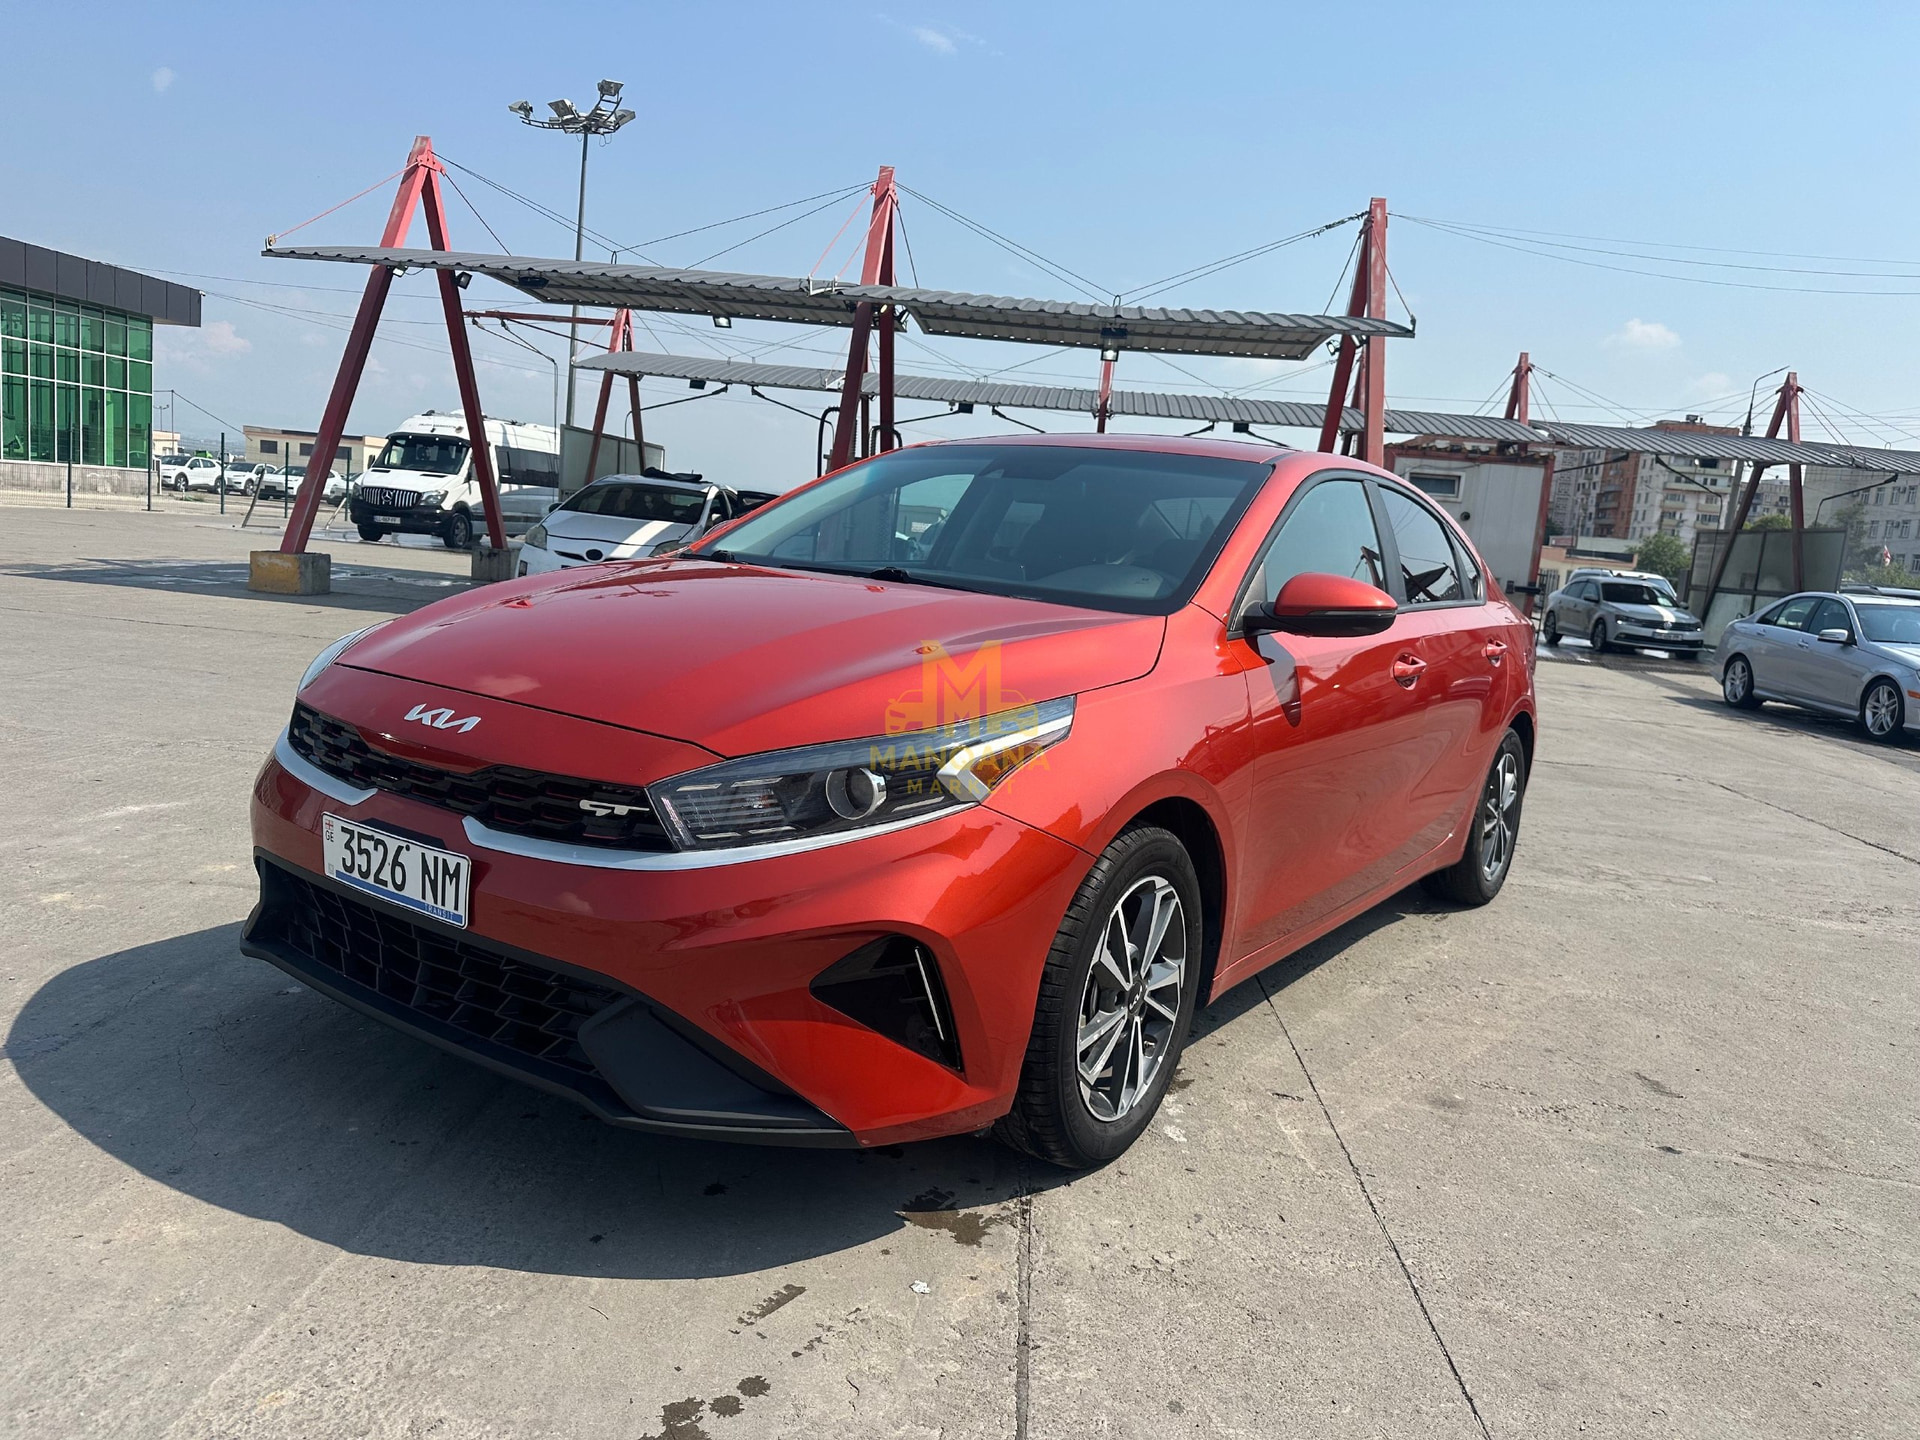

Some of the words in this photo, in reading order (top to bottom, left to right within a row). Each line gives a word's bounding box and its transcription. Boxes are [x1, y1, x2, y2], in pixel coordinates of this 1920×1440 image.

[404, 703, 482, 734] KIA
[579, 799, 650, 817] GT
[325, 830, 335, 843] GE
[340, 825, 407, 893] 3526
[421, 852, 462, 912] NM
[424, 903, 455, 922] TRANSIT
